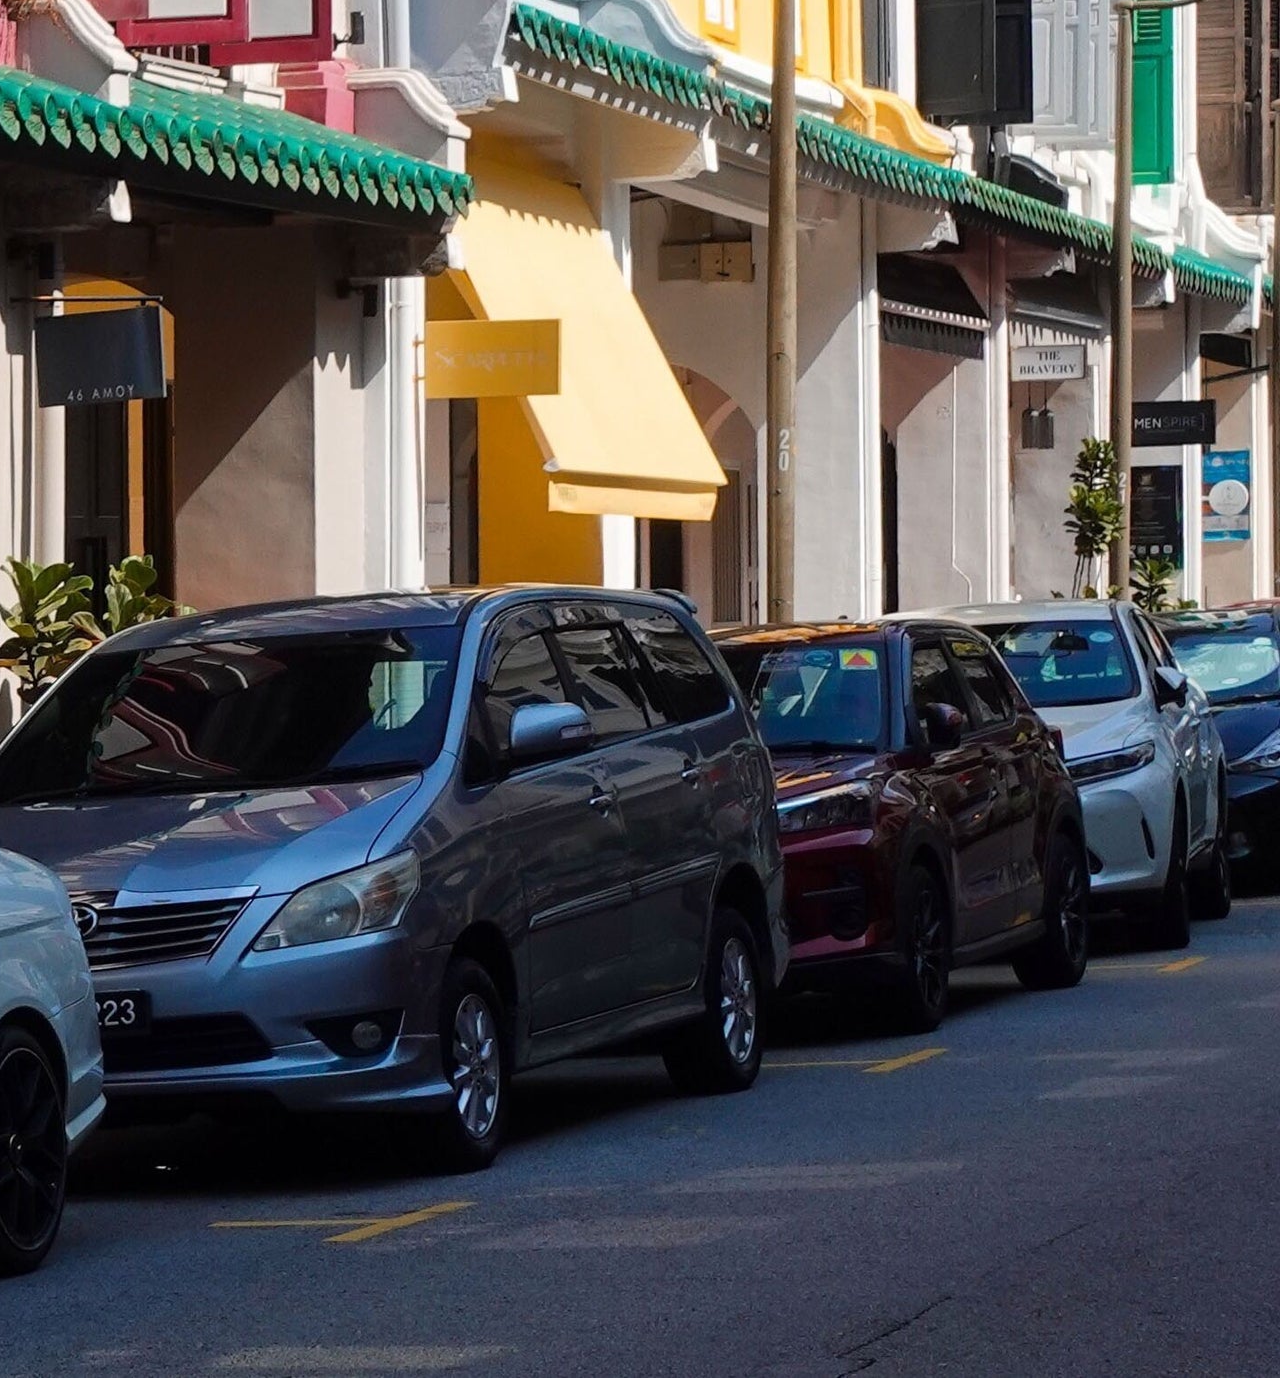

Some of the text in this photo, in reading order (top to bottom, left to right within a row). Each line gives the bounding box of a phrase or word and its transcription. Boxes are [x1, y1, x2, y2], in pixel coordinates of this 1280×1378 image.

[1036, 350, 1061, 361] THE
[1019, 363, 1077, 375] BRAVERY
[67, 384, 135, 402] 46 AMOY
